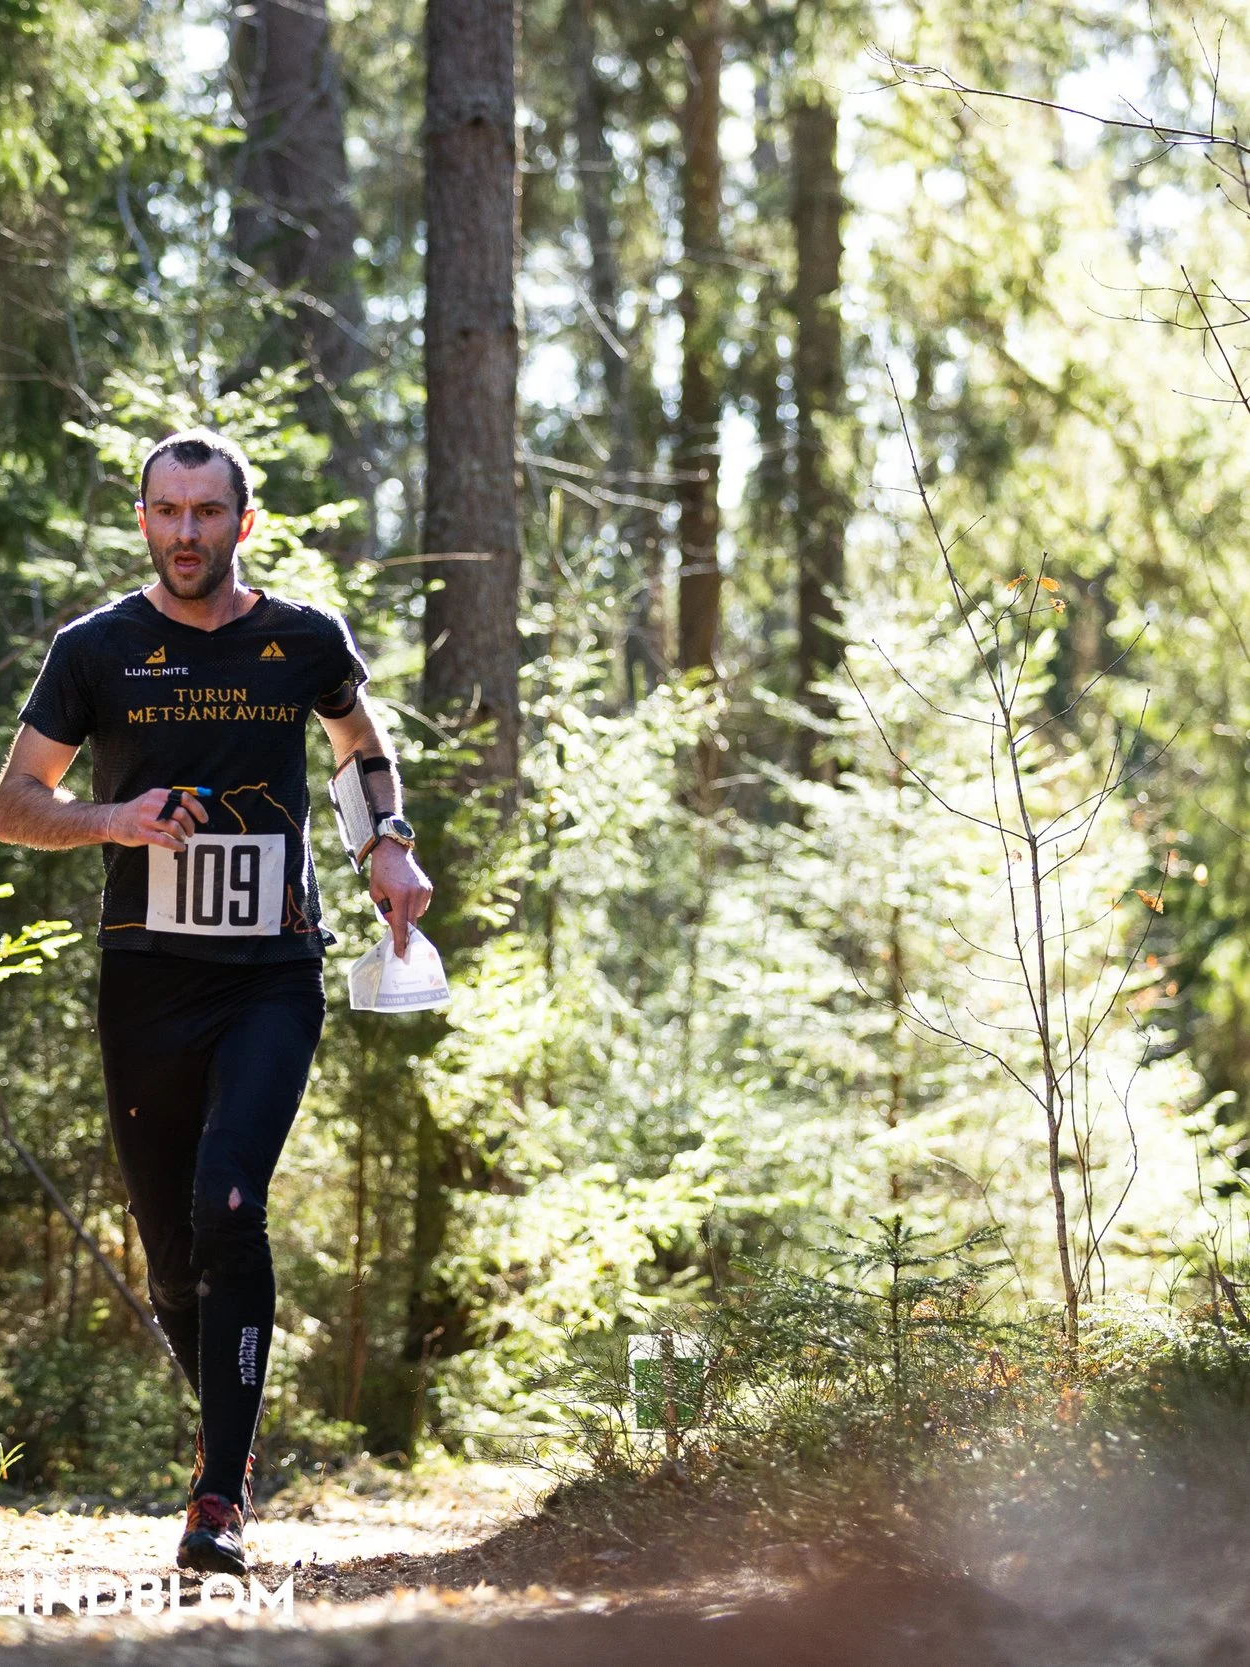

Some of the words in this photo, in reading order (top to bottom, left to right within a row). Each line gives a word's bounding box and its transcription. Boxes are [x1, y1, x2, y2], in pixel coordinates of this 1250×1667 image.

[125, 667, 189, 676] LUMONITE
[173, 688, 248, 703] TURUN
[127, 703, 298, 724] METSÄNKÄVIJÄT
[173, 843, 261, 927] 109
